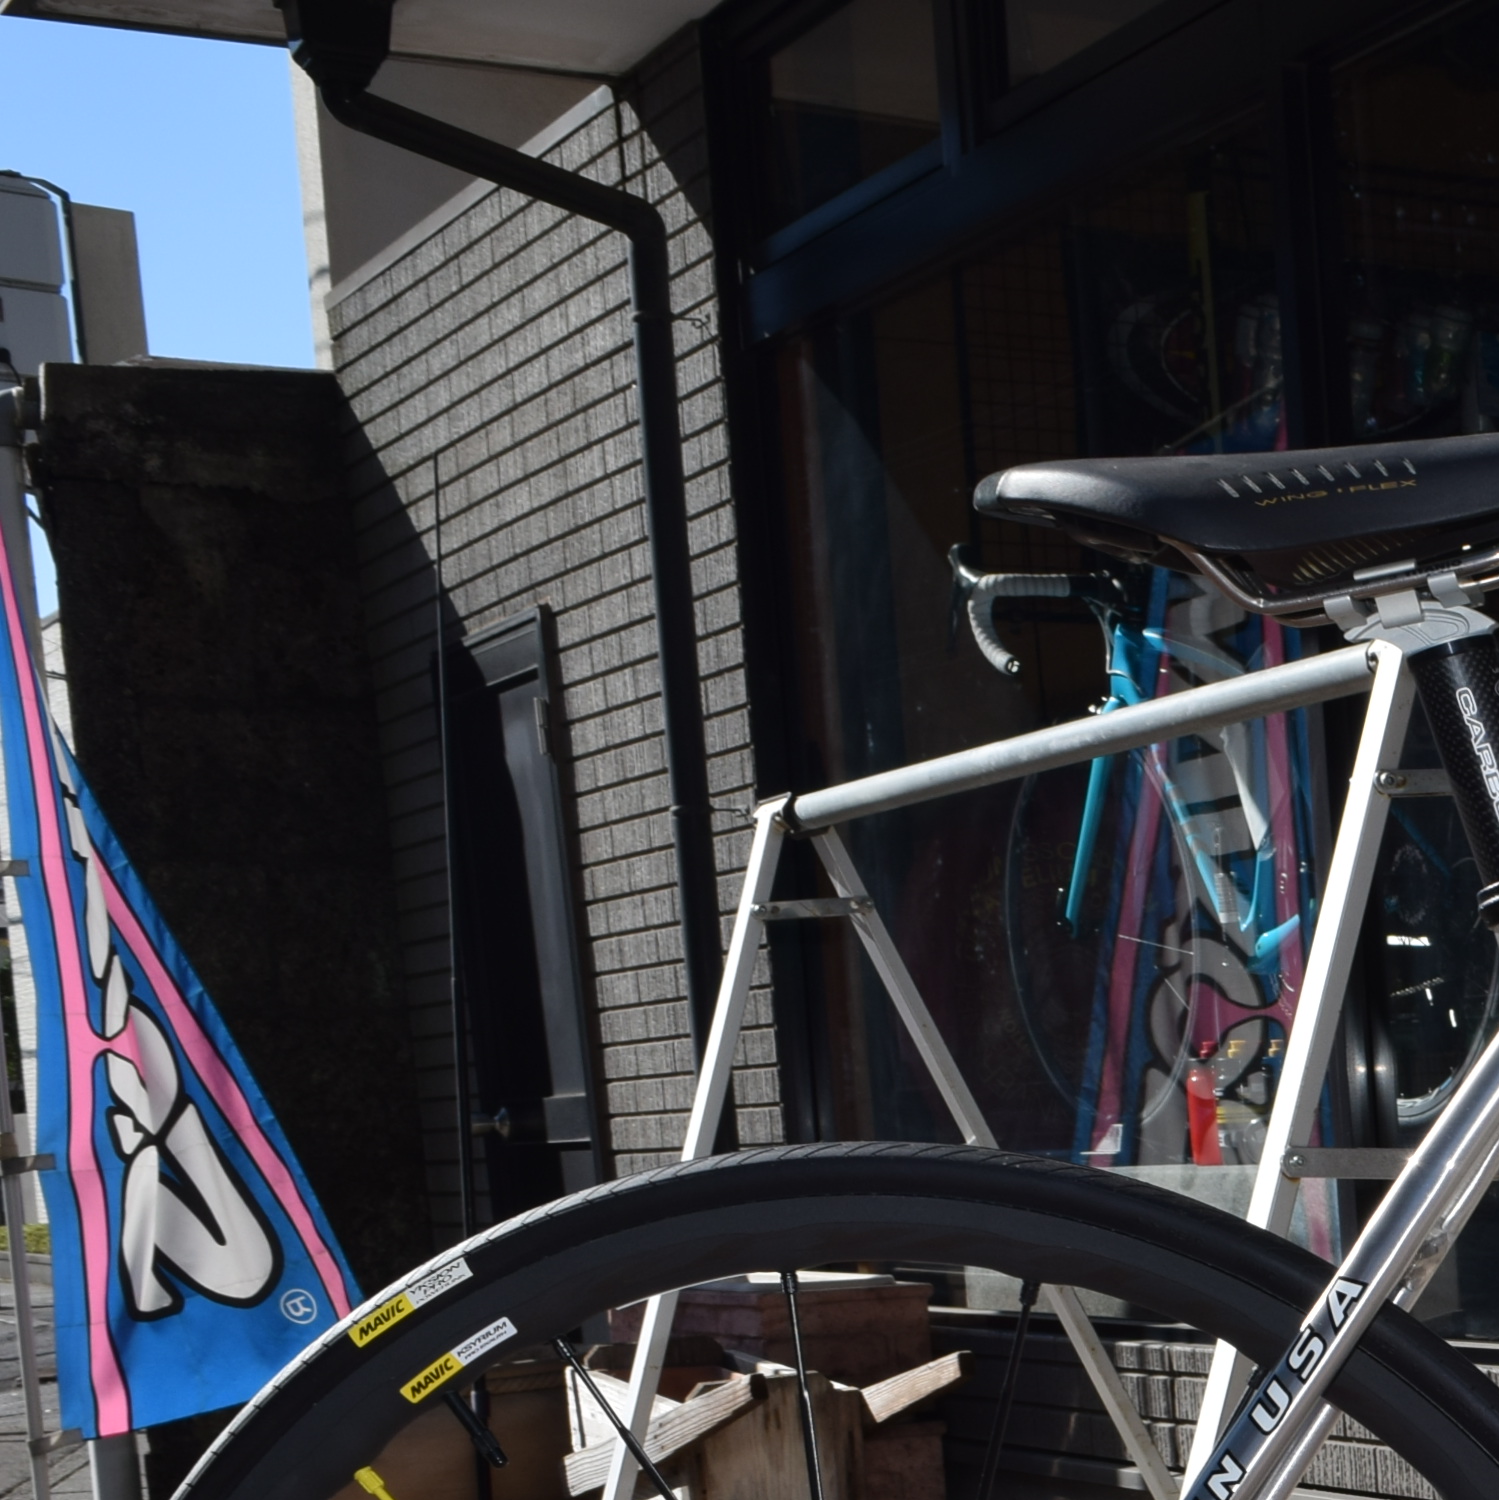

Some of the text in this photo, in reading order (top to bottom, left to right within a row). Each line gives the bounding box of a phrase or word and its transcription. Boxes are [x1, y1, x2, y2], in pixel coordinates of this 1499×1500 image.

[1255, 479, 1417, 506] WING FLEX
[359, 1300, 405, 1340] MAVIC
[457, 1321, 507, 1357] KSYRIUM
[1250, 1277, 1368, 1437] USA
[410, 1358, 454, 1399] MAVIC
